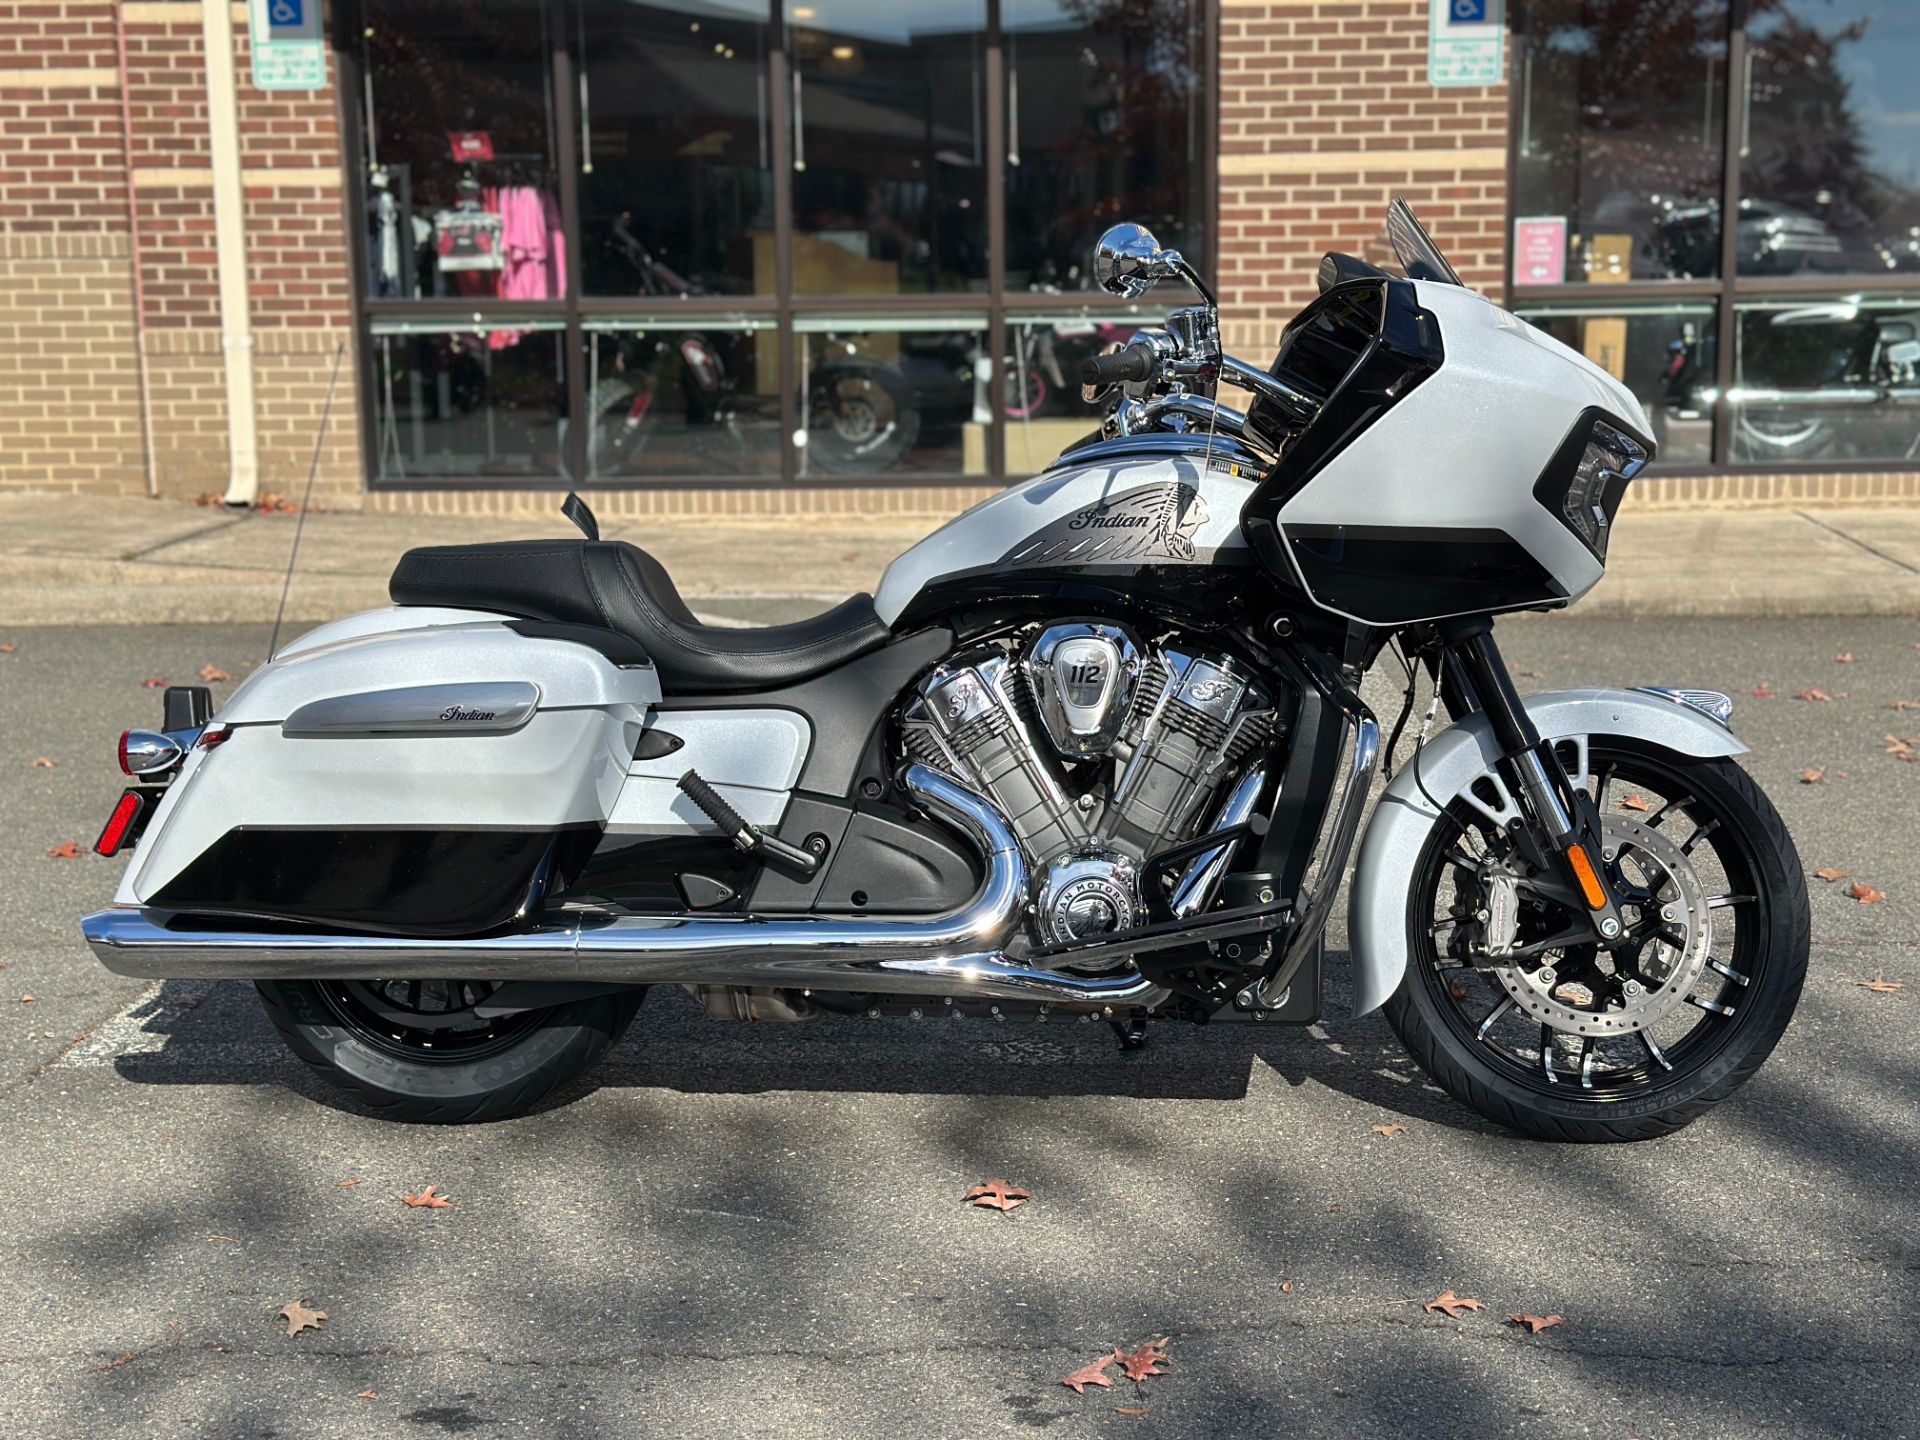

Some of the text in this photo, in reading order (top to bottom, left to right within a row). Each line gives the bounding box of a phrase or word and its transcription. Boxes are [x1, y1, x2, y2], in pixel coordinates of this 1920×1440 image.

[1068, 508, 1150, 530] Indian
[1070, 665, 1100, 683] 112
[440, 704, 495, 721] Indian
